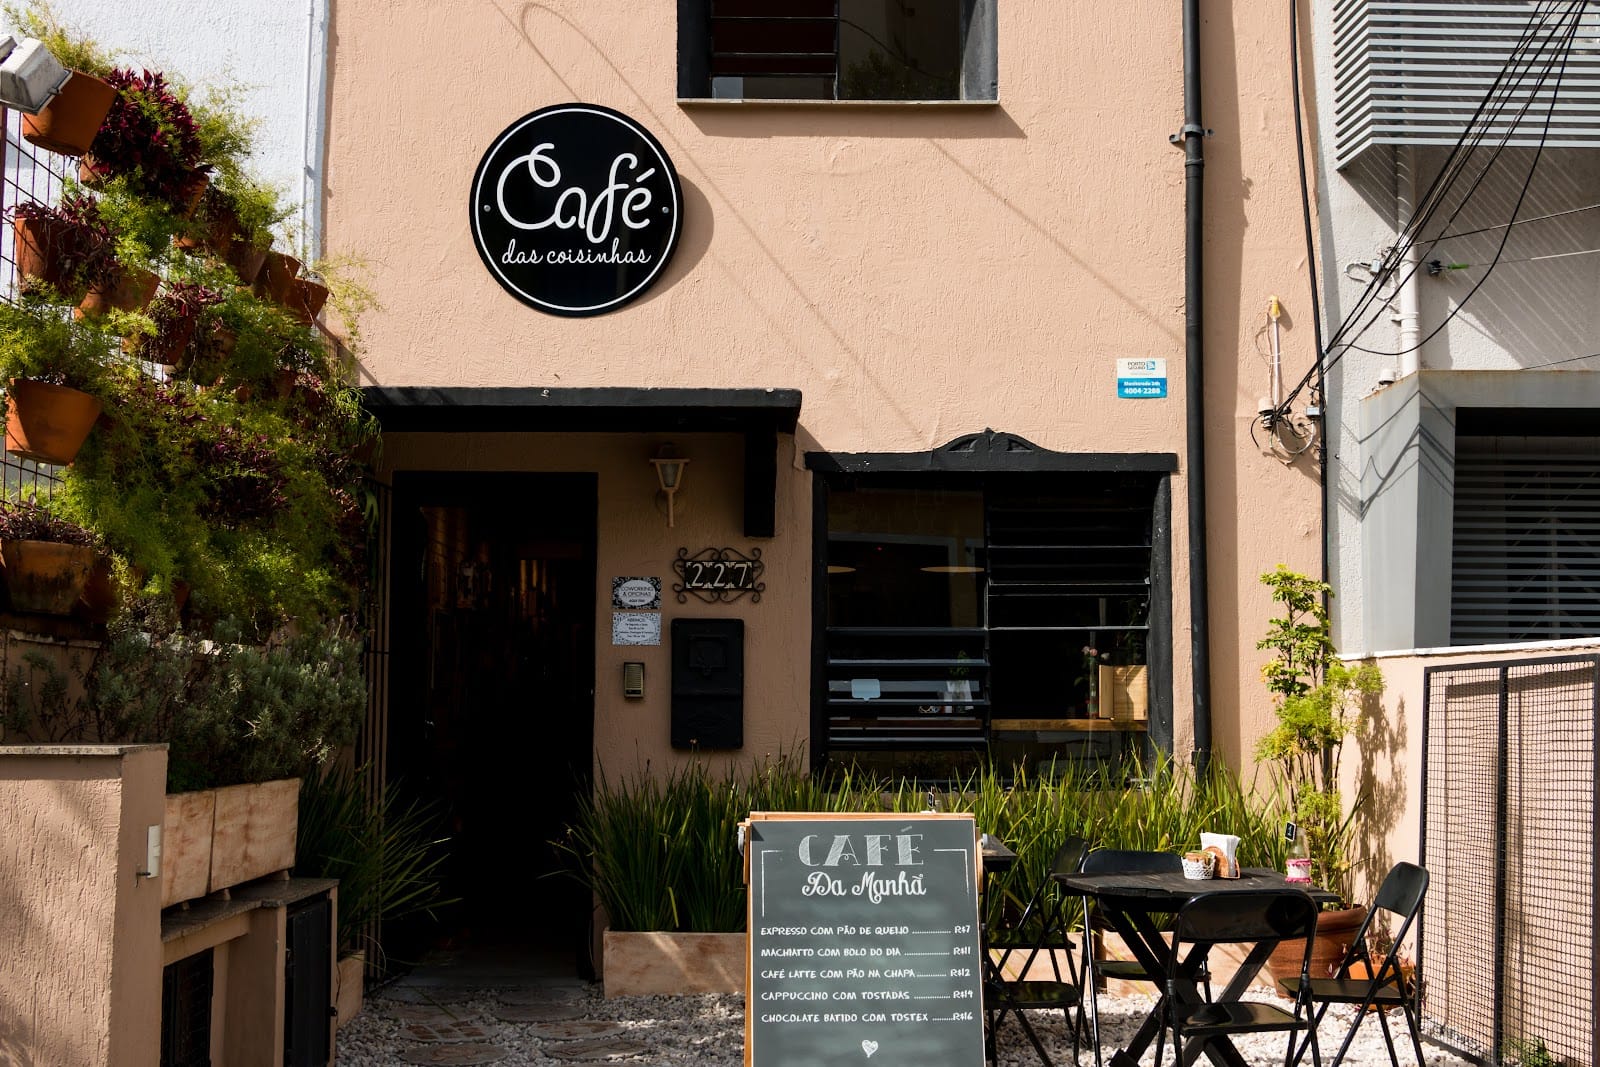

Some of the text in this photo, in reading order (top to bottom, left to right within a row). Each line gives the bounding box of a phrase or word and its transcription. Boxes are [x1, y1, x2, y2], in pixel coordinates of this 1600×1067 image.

[497, 142, 655, 244] Café
[502, 237, 652, 264] das coisinhas
[690, 563, 748, 587] 227
[798, 826, 924, 867] CAFÉ
[801, 871, 927, 905] Da Manhã
[760, 924, 971, 936] EXPRESSO COM PÃO DE QUEIJO R$7
[760, 945, 971, 958] MACHIATTO COM BOLO DO DIA R$11
[760, 967, 971, 979] CAFÉ LATTE COM PÃO NA CHAPA R$12
[760, 990, 829, 1001] CAPPUCCINO
[832, 990, 857, 1001] COM
[861, 990, 911, 1001] TOSTADAS
[760, 1013, 821, 1024] CHOCOLATE
[823, 1013, 858, 1023] BATIDO
[861, 1013, 887, 1023] COM
[890, 1012, 929, 1023] TOSTEX
